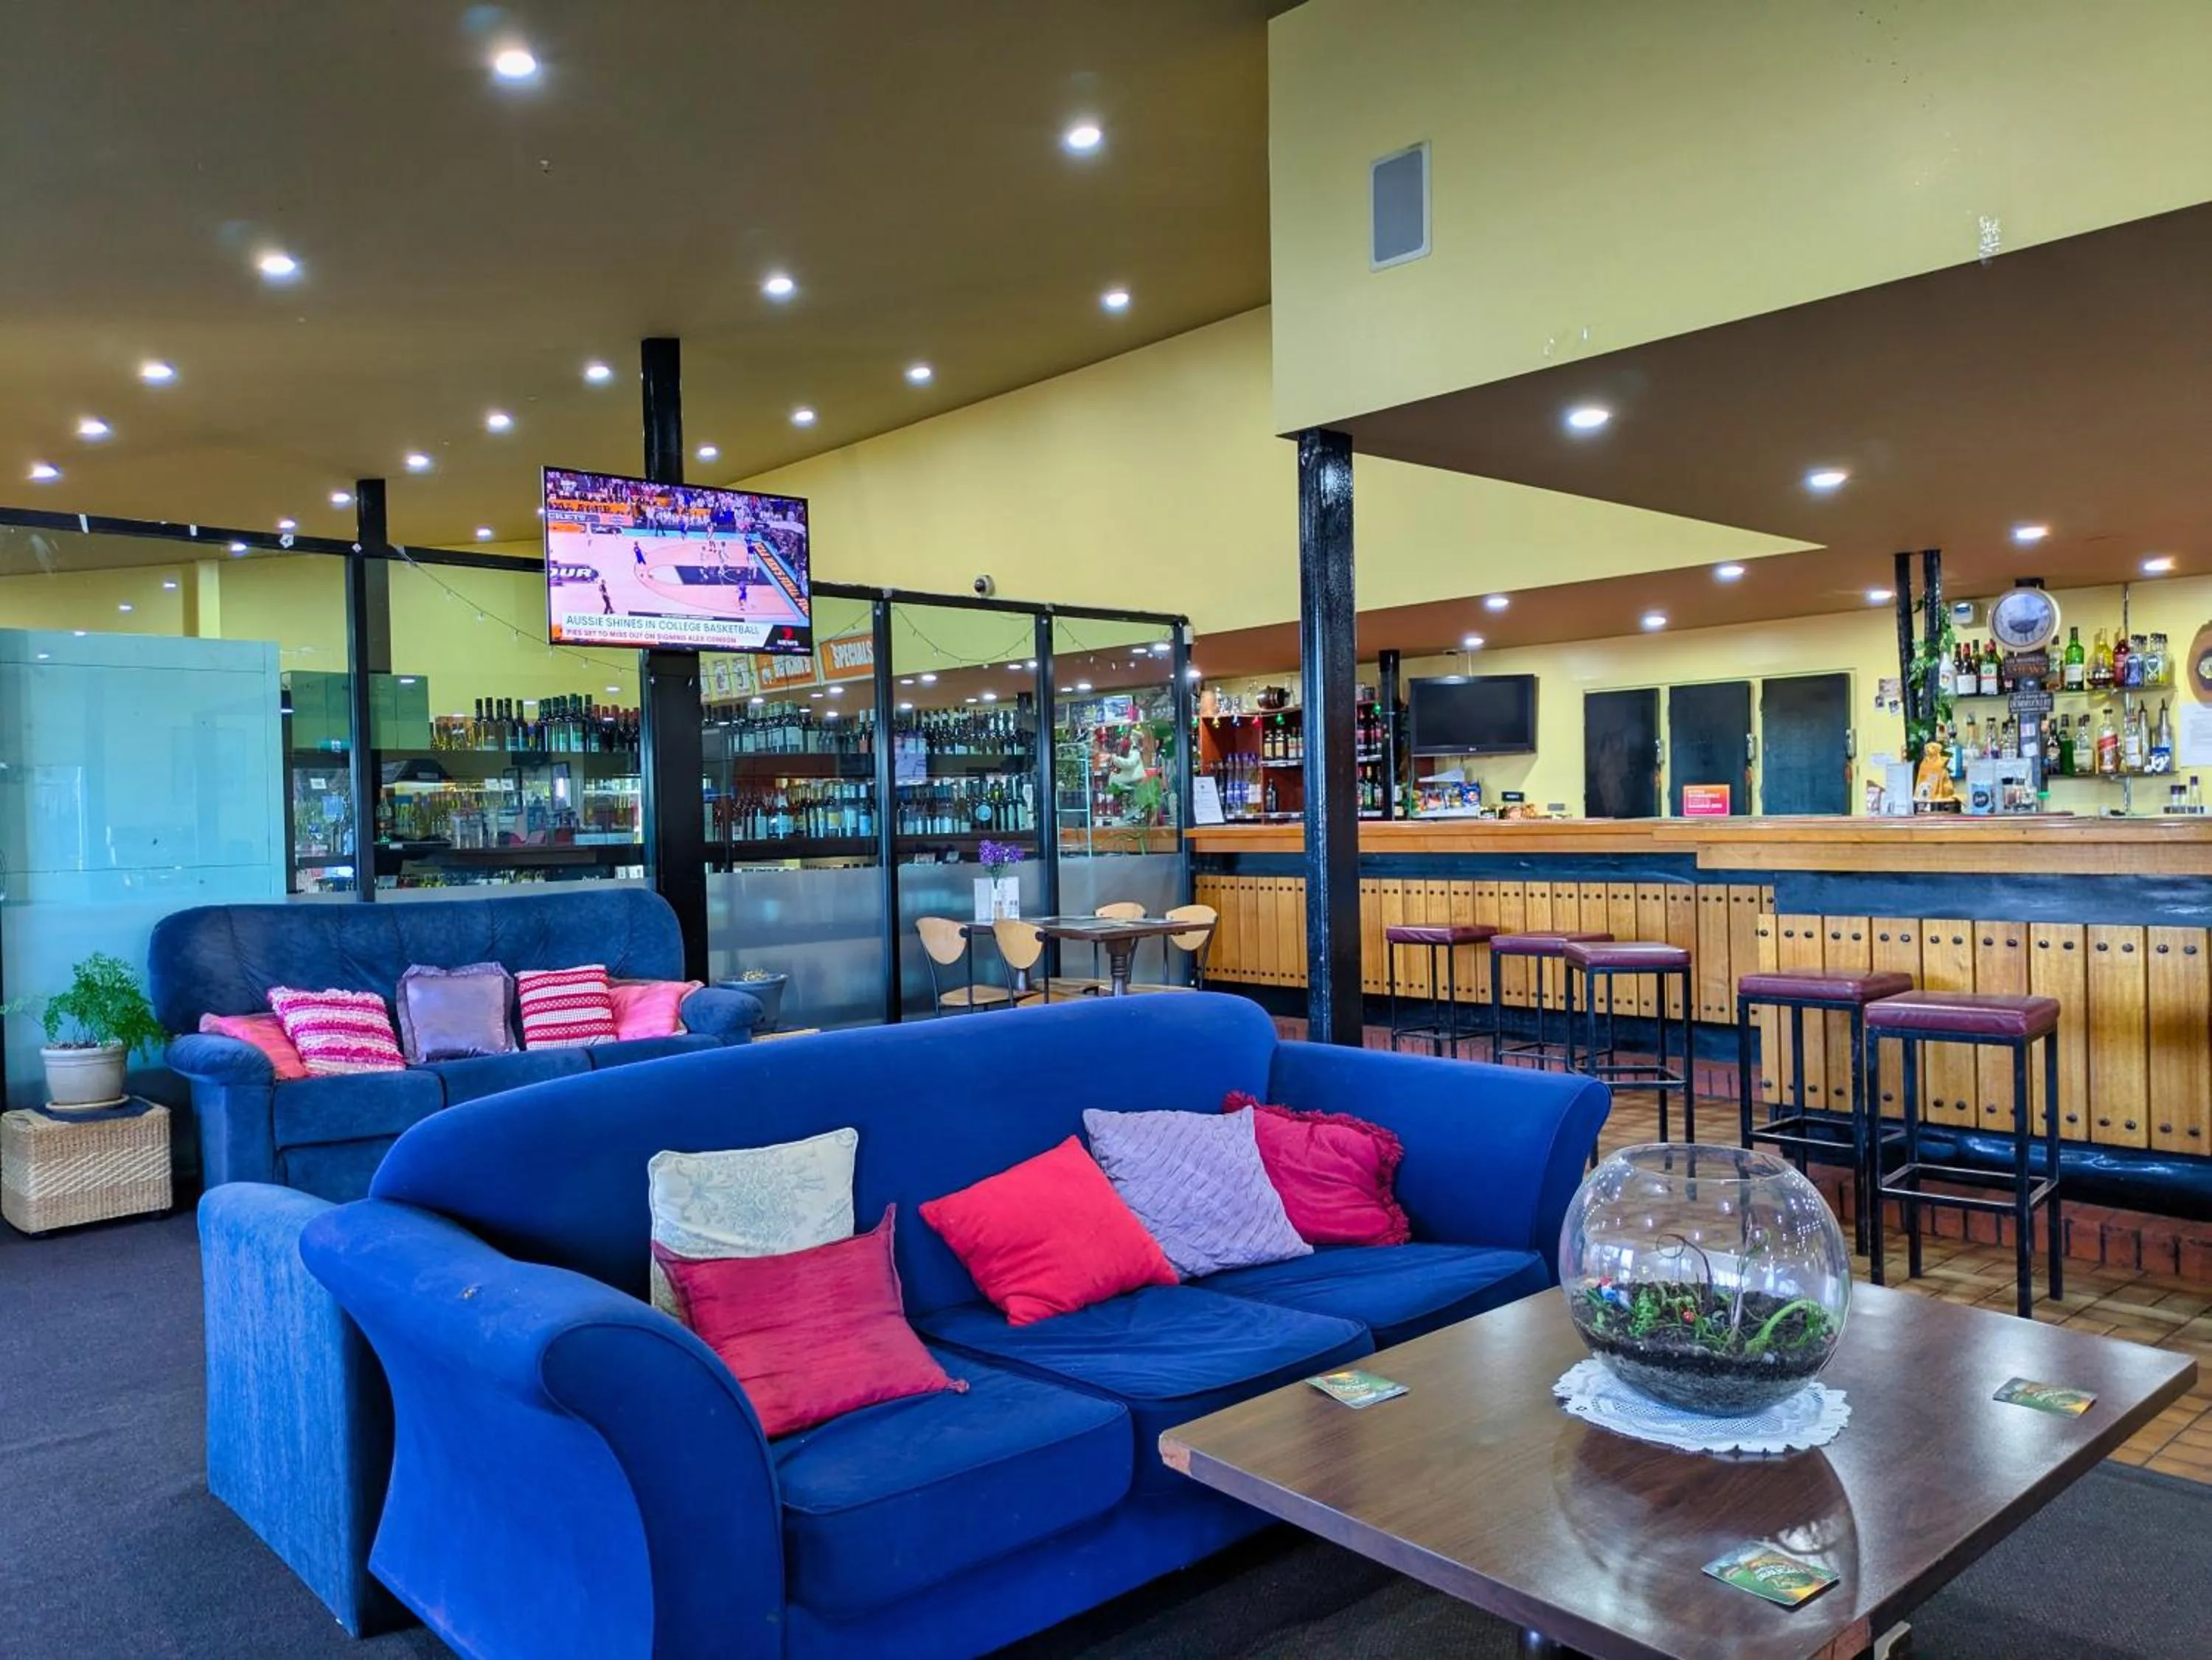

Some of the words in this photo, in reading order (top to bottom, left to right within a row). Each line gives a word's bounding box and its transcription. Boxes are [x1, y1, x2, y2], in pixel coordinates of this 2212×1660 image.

[566, 615, 605, 627] AUSSIE
[606, 618, 644, 630] SHINES
[646, 620, 655, 630] IN
[658, 621, 700, 632] COLLEGE
[703, 623, 759, 635] BASKETBALL
